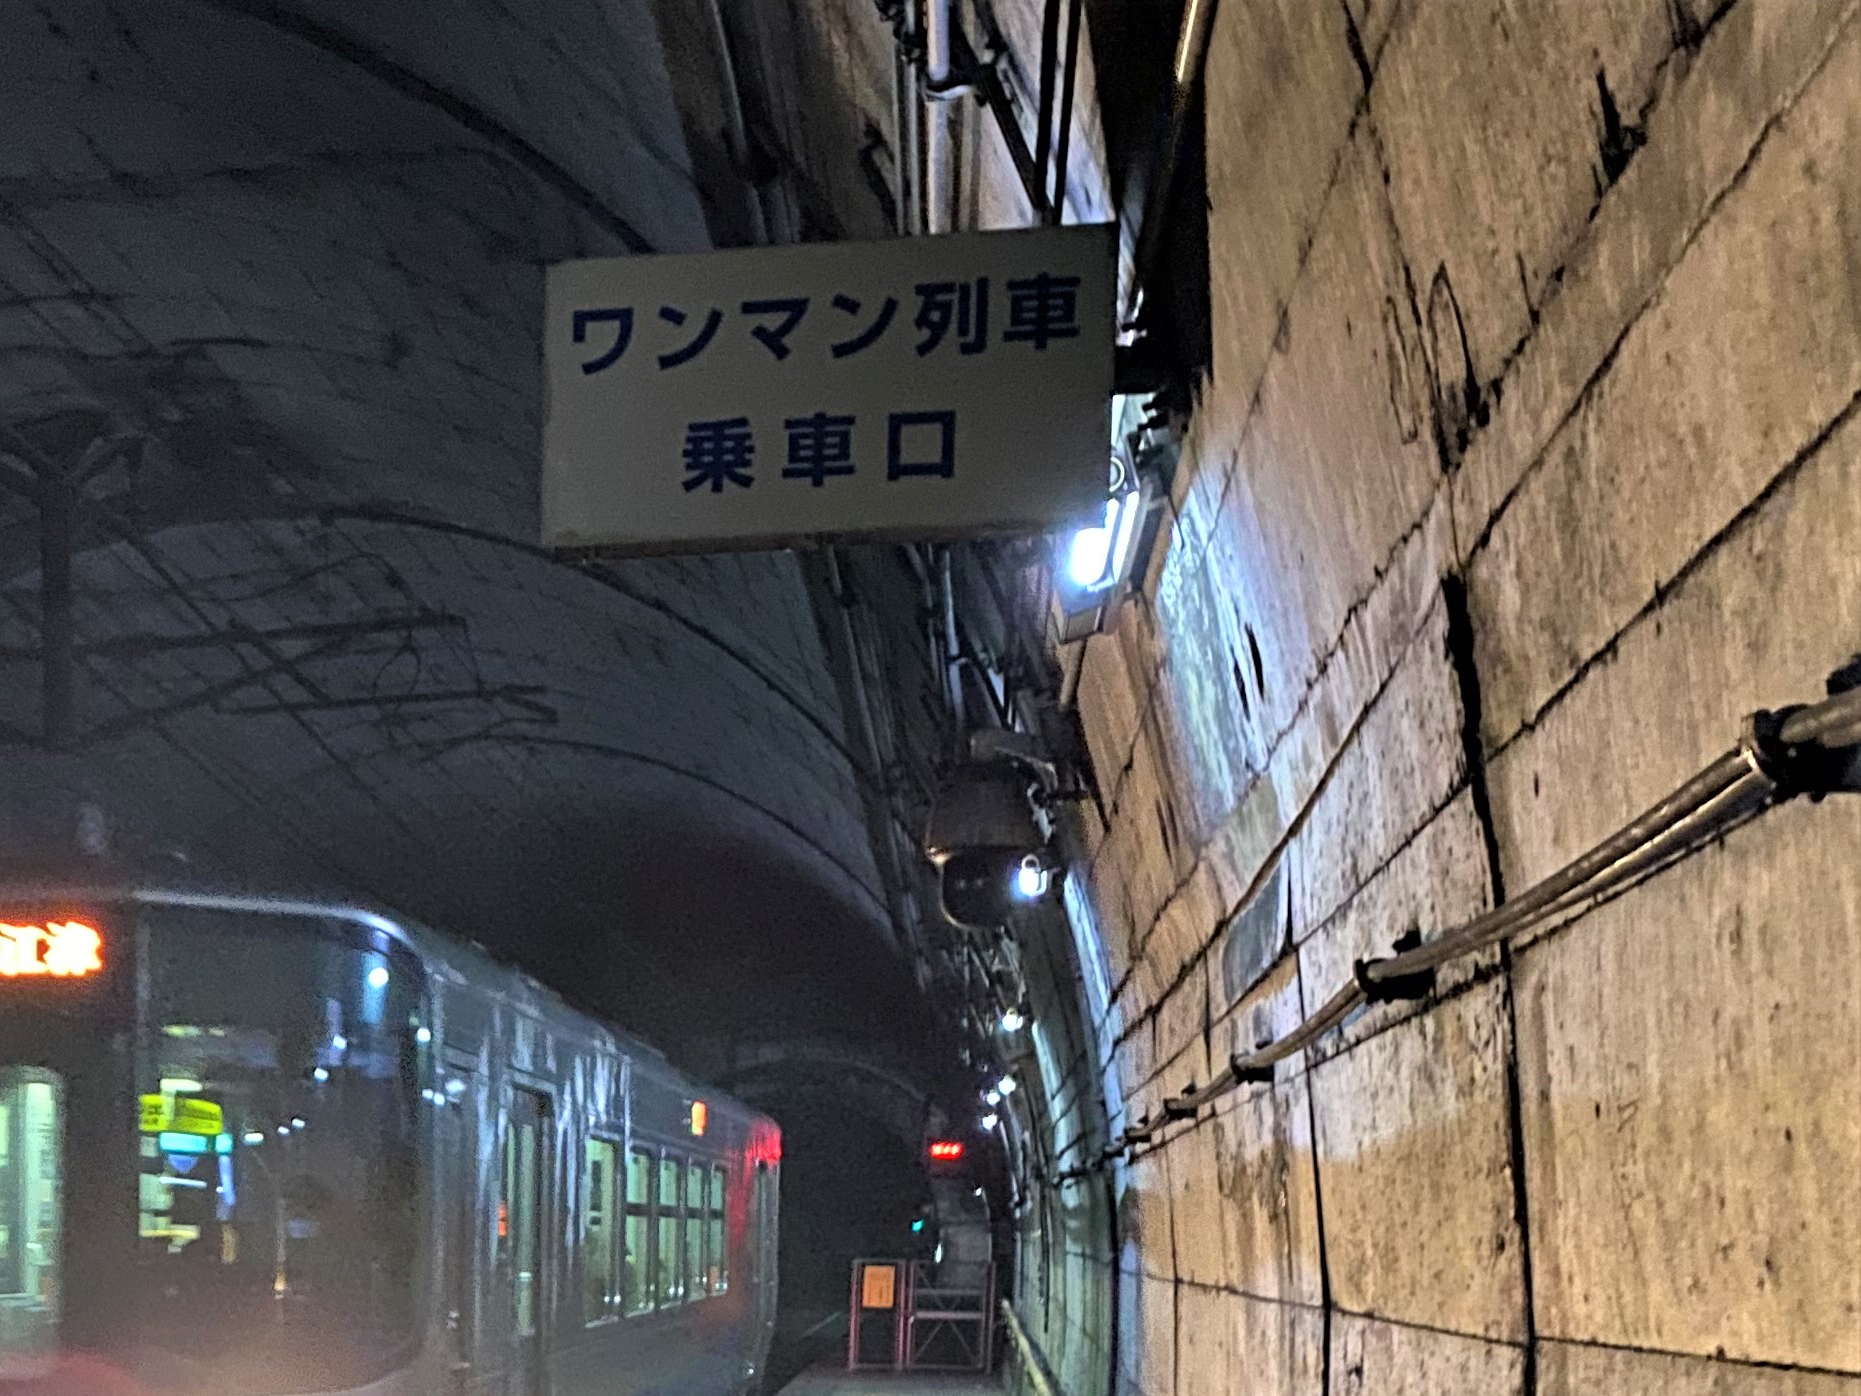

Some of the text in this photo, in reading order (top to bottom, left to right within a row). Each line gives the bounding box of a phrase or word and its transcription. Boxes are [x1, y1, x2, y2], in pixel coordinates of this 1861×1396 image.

[572, 272, 1081, 375] ワンマン列車
[682, 411, 957, 493] 乗車口
